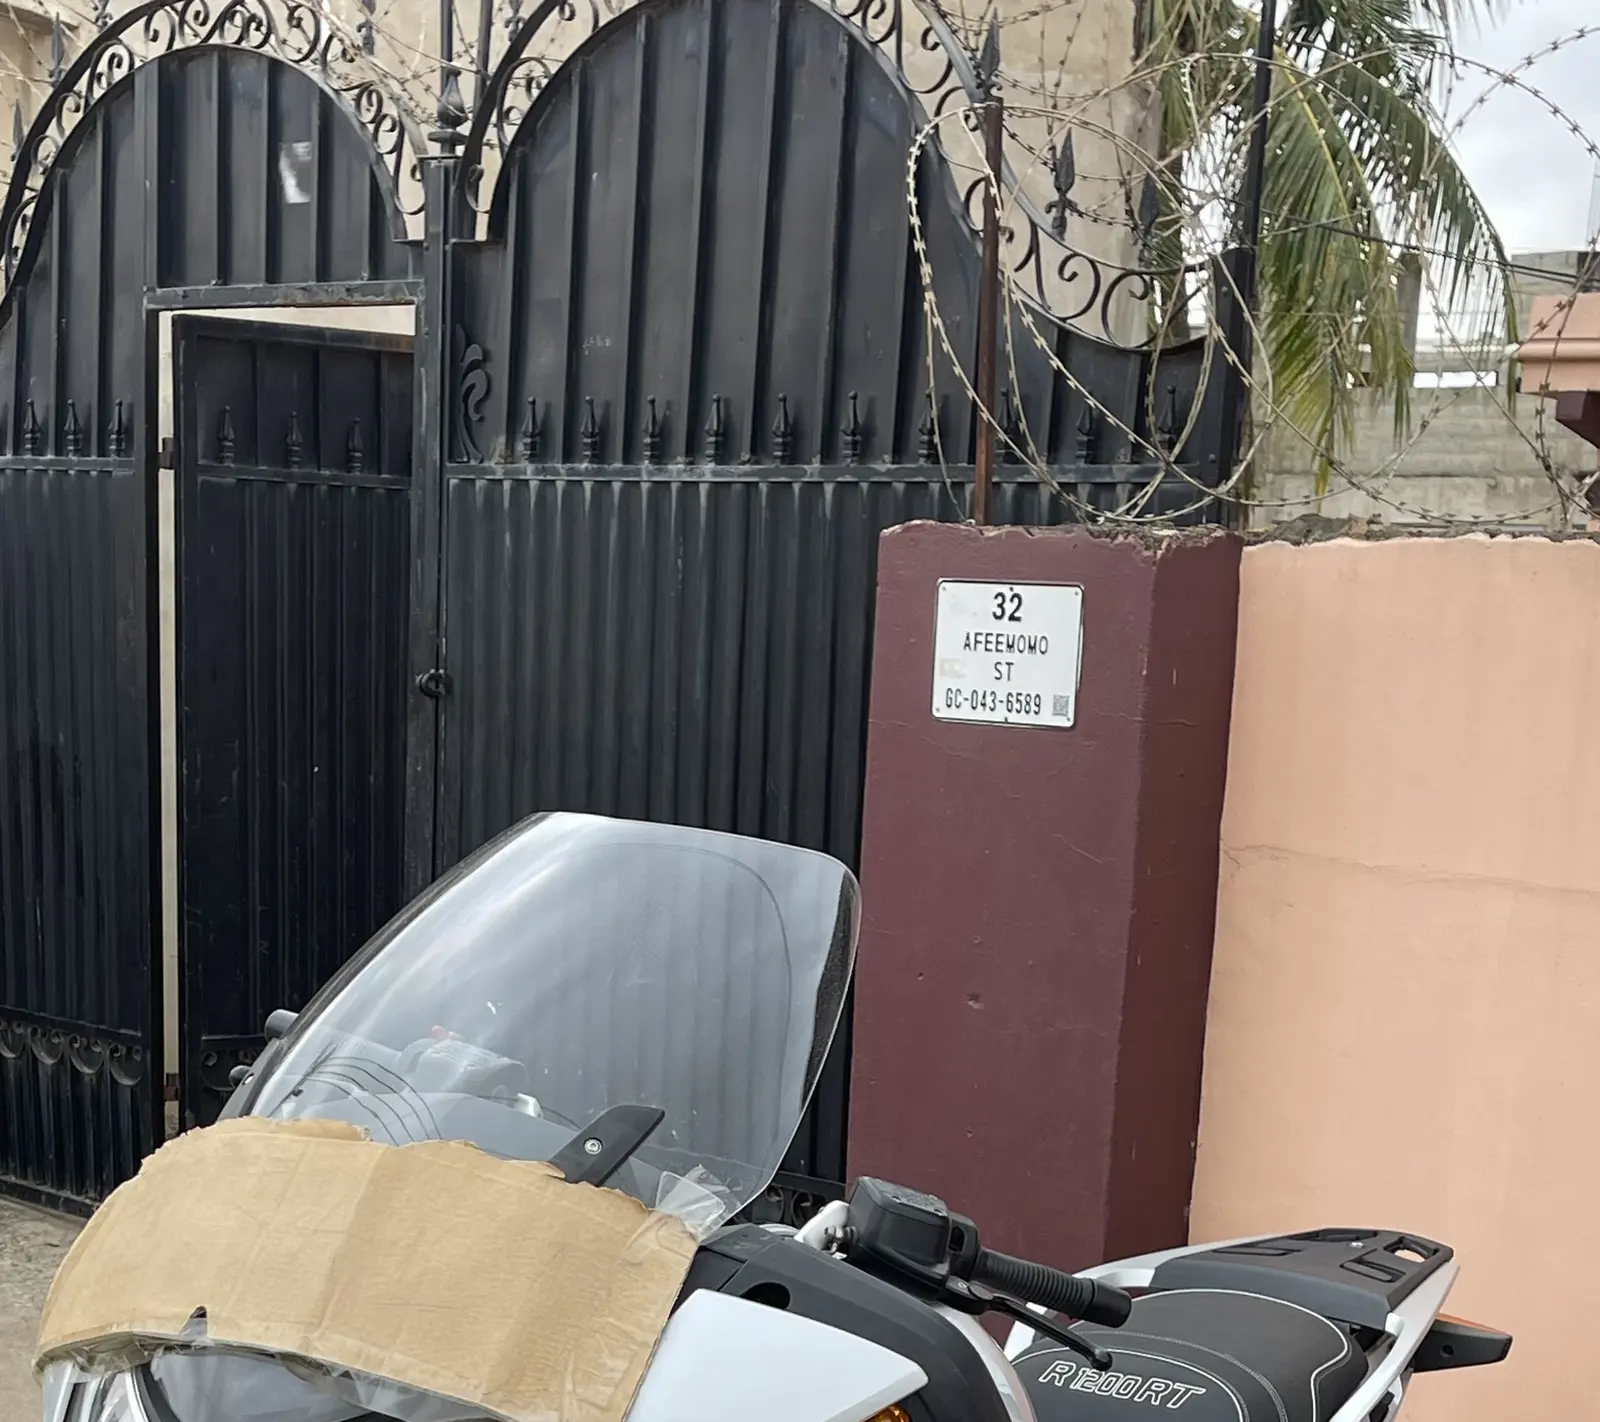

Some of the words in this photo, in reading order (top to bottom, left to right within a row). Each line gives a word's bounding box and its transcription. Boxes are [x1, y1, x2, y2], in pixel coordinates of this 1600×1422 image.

[992, 591, 1023, 622] 32
[963, 631, 1049, 655] AFEEMOMO
[994, 661, 1015, 682] ST
[945, 687, 1042, 716] GC-043-6589
